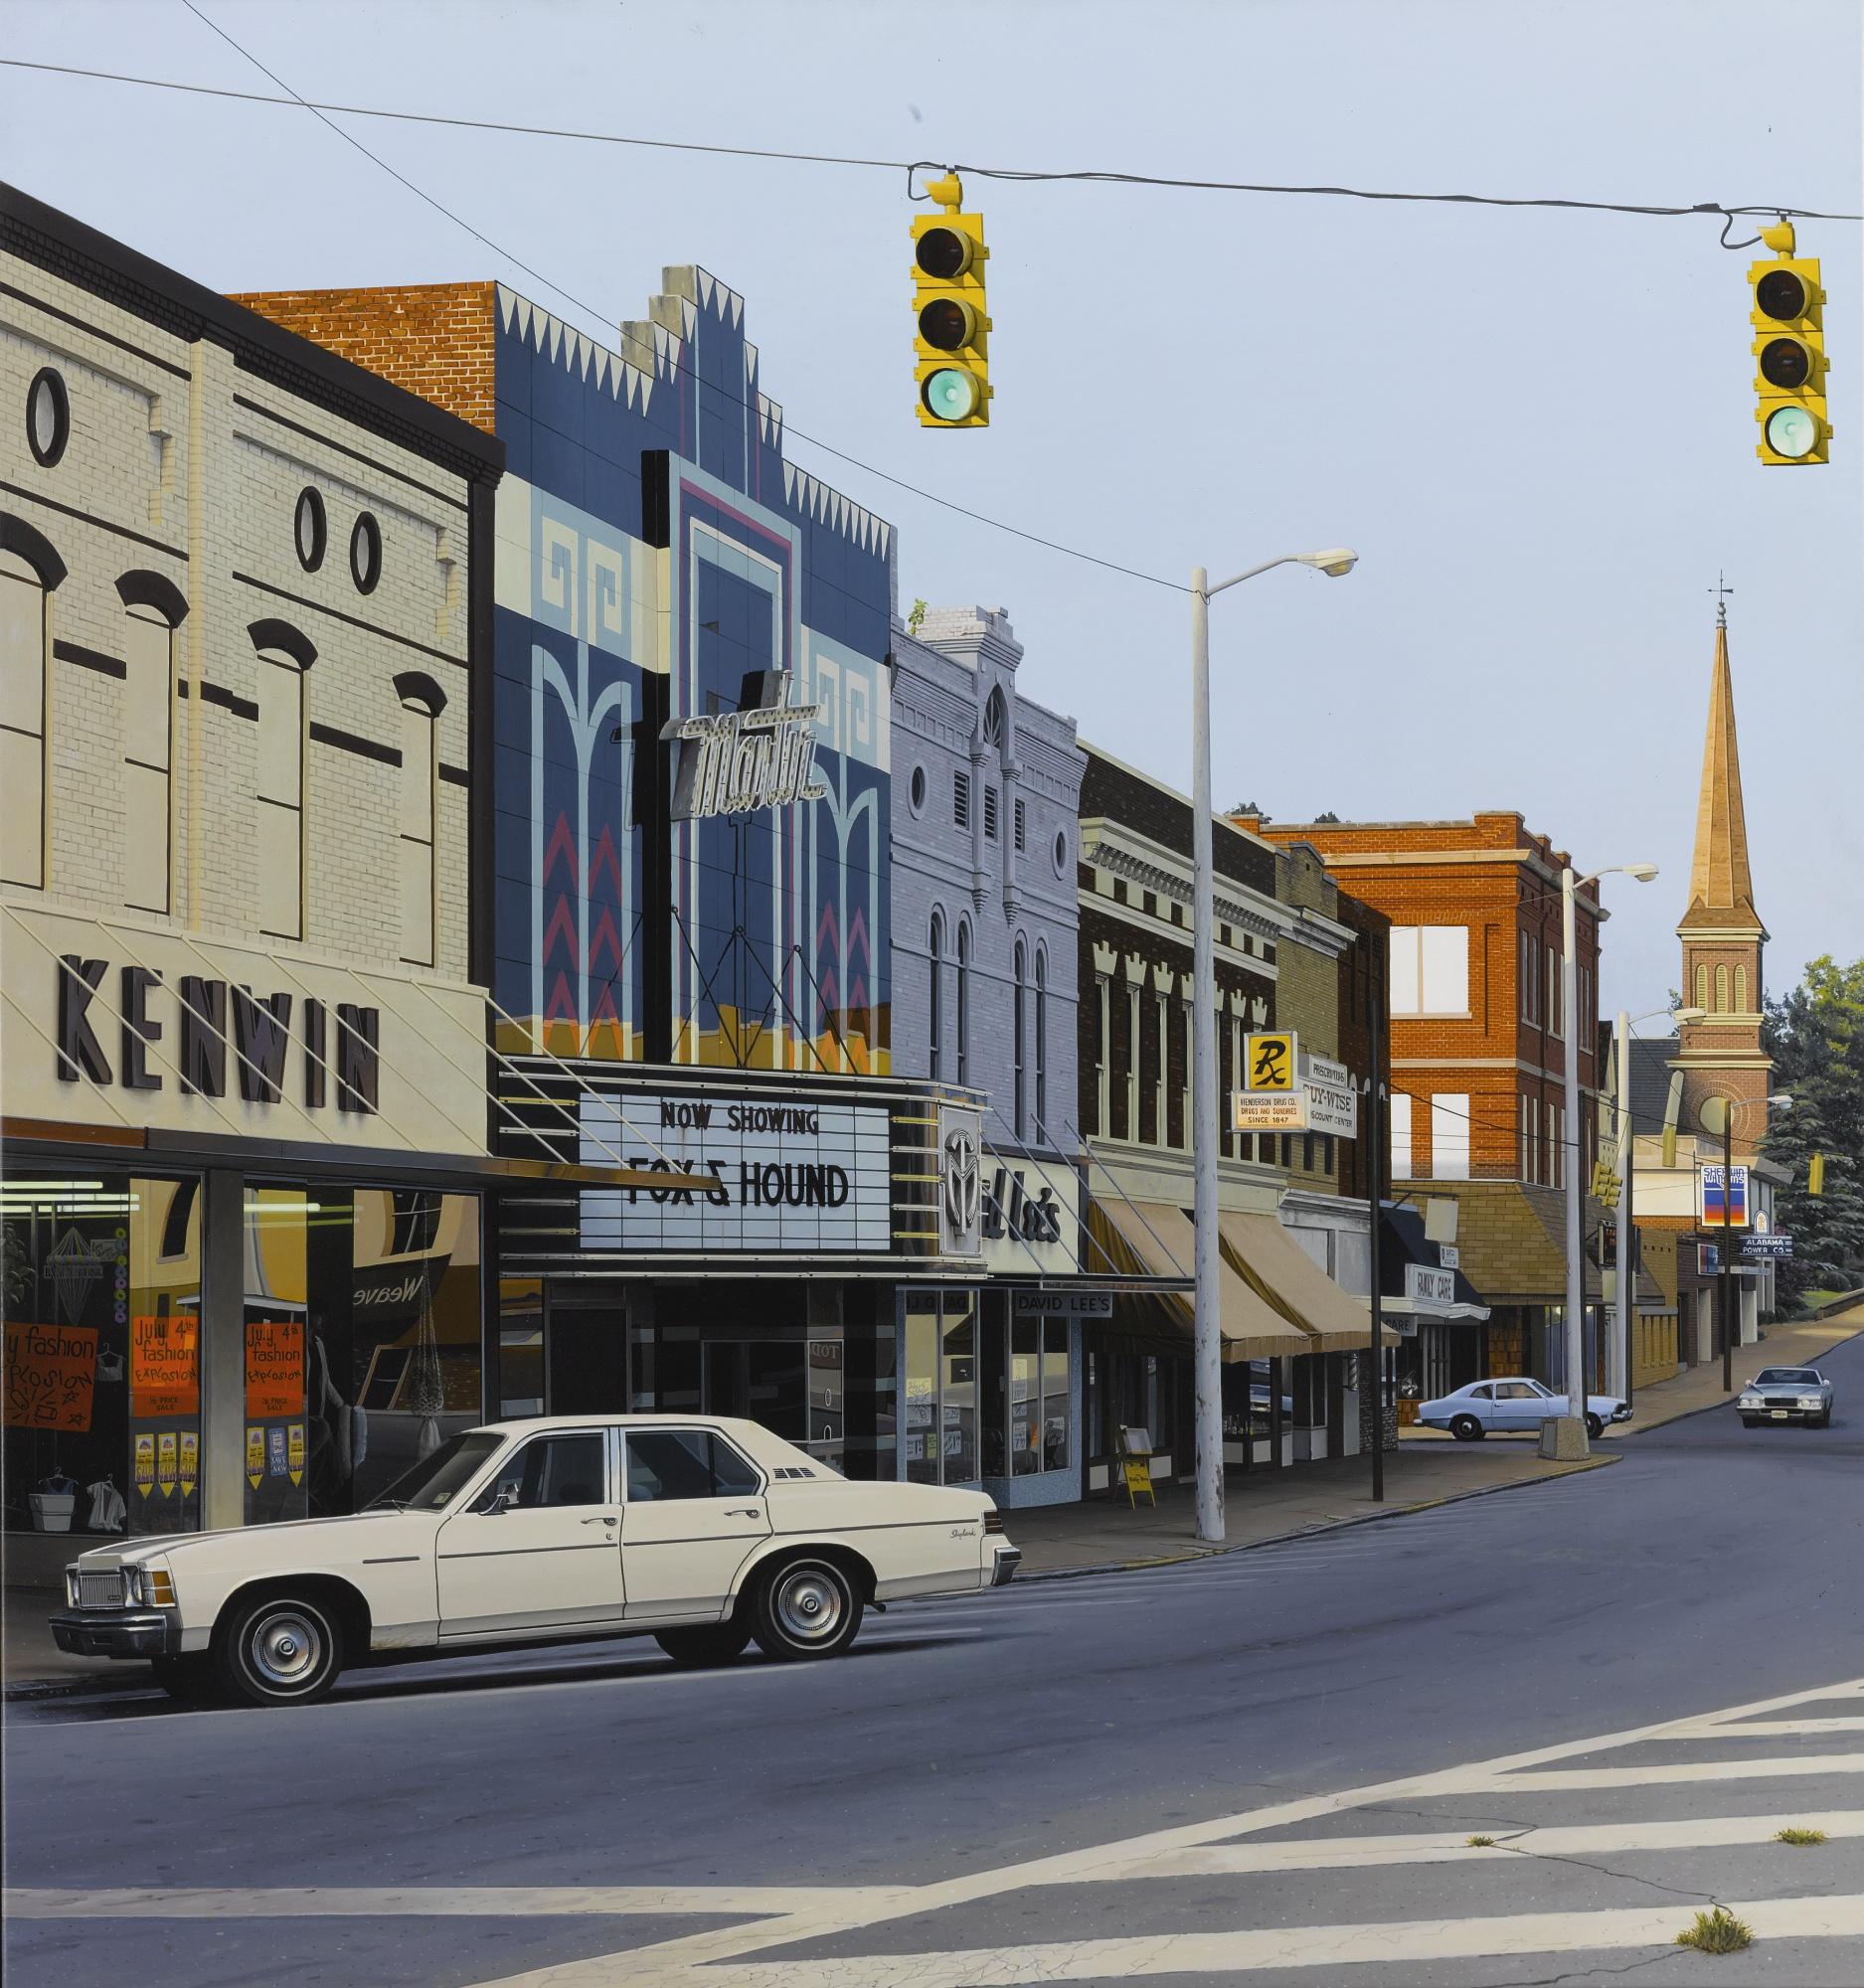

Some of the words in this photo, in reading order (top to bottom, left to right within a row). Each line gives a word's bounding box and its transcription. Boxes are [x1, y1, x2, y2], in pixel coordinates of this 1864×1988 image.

[58, 953, 380, 1115] KENWIN
[1240, 1097, 1271, 1106] HENDERSON
[1273, 1097, 1287, 1106] DRUG
[660, 1101, 713, 1130] NOW
[727, 1105, 818, 1135] SHOWING
[1334, 1115, 1353, 1128] CENTER
[741, 1161, 849, 1208] HOUND
[1438, 1276, 1451, 1300] CARE
[1018, 1295, 1063, 1310] DAVID
[1071, 1296, 1109, 1311] LEE'S
[25, 1326, 94, 1359] fashion
[135, 1320, 166, 1346] July
[175, 1320, 194, 1339] 4th
[248, 1326, 273, 1347] July
[141, 1339, 195, 1362] fashion
[253, 1341, 300, 1362] fashion
[135, 1367, 197, 1383] EXPLOSION
